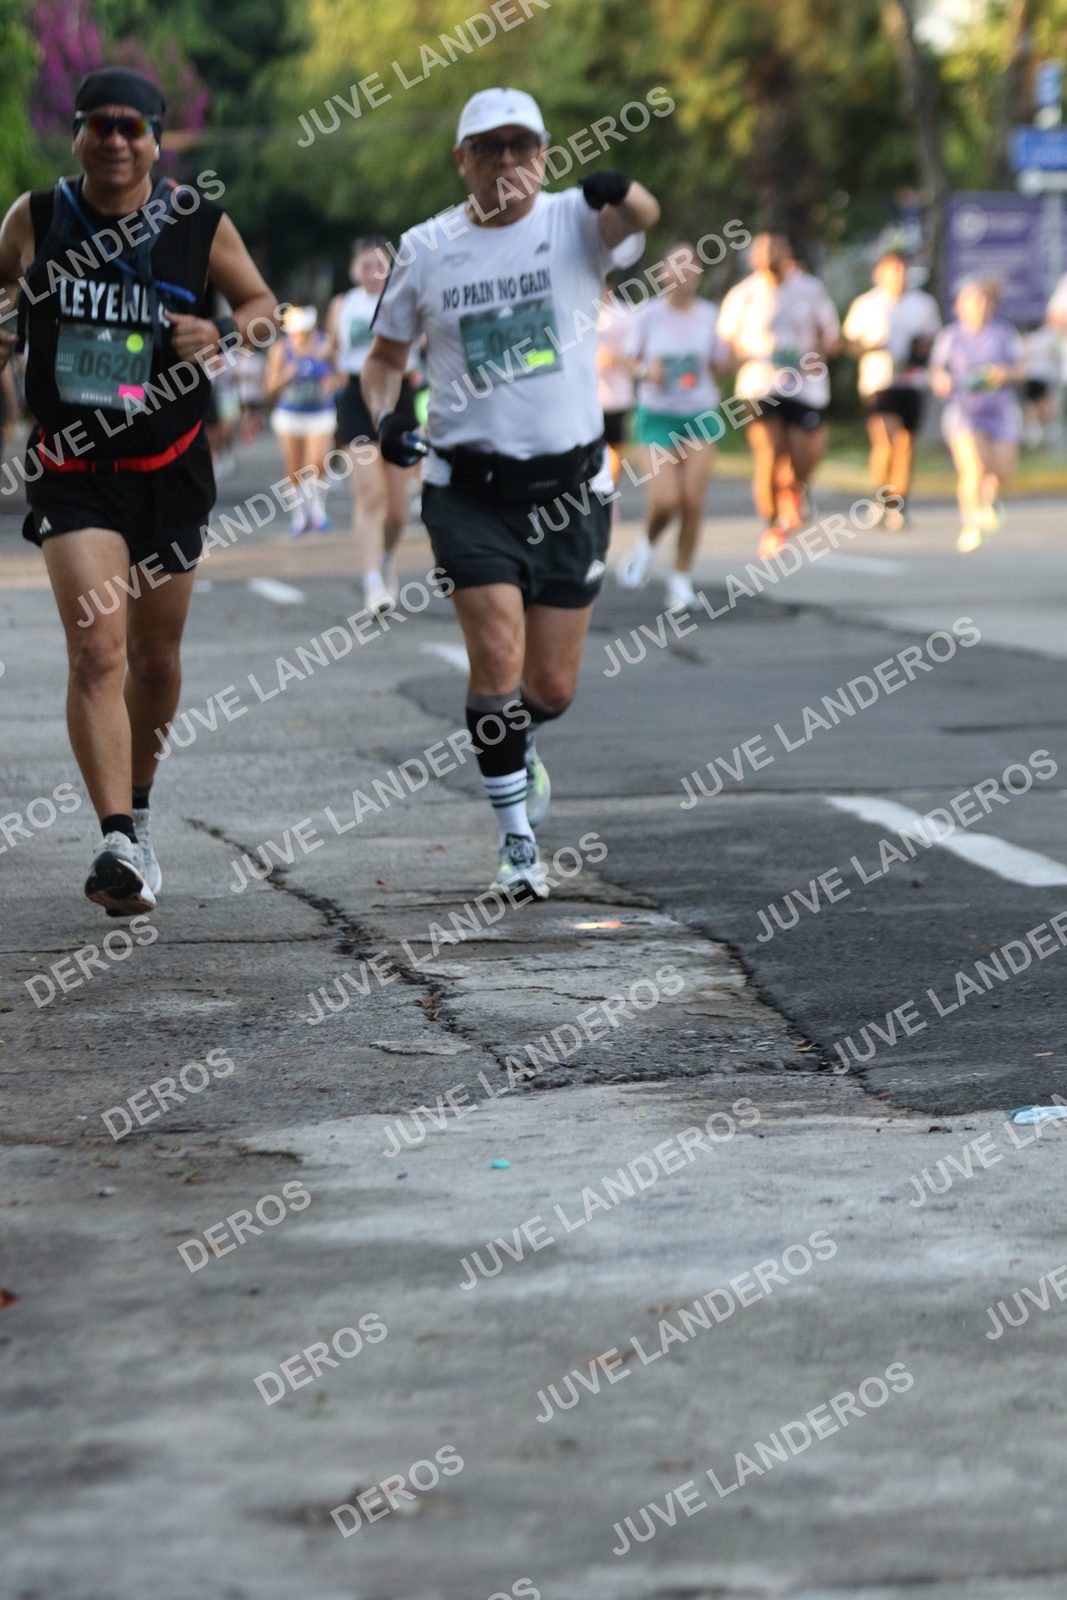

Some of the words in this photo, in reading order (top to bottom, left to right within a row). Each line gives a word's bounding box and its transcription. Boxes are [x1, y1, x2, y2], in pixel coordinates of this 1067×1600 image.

[442, 288, 460, 311] NO
[463, 278, 495, 307] PAIN
[498, 274, 517, 300] NO
[78, 349, 147, 383] 0620
